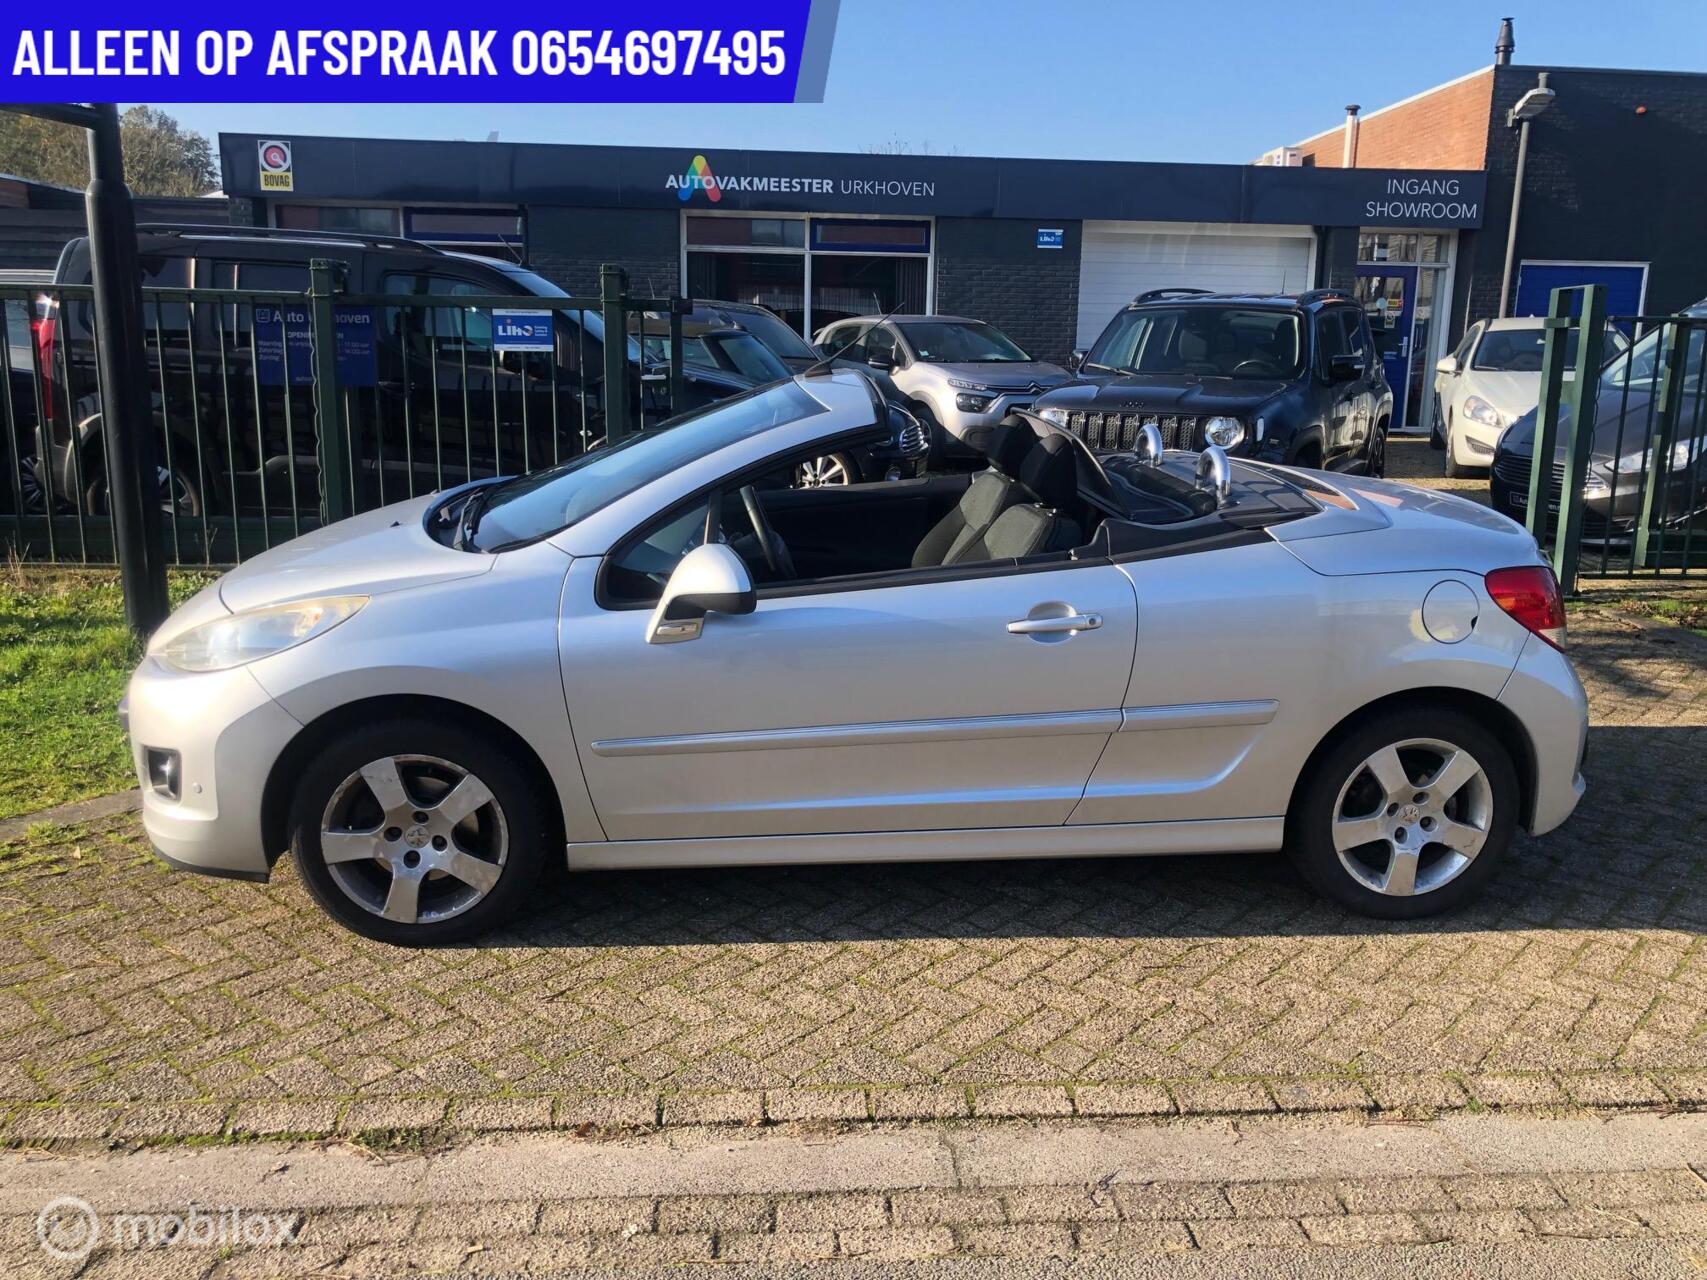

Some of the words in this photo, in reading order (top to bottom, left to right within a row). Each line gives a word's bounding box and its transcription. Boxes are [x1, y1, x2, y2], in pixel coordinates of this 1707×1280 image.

[264, 174, 290, 187] BOVAG
[665, 174, 834, 194] AUTOVAKMEESTER
[841, 179, 935, 196] URKHOVEN
[1387, 179, 1460, 195] INGANG
[1366, 201, 1477, 219] SHOWROOM
